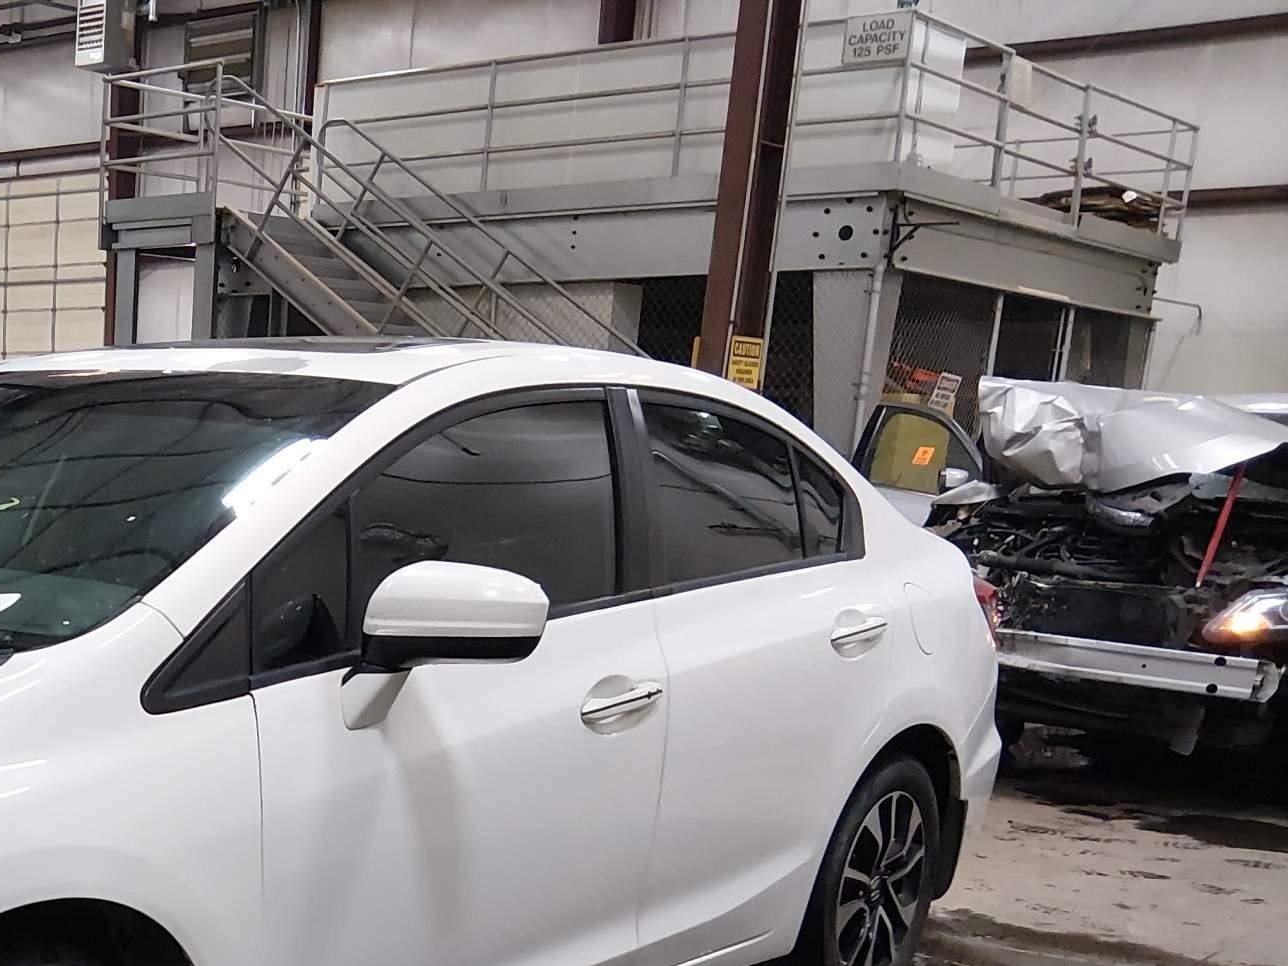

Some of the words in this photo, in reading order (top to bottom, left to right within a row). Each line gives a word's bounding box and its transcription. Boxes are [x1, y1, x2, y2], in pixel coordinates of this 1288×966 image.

[862, 18, 895, 33] LOAD
[848, 30, 906, 46] CAPACITY
[853, 46, 871, 58] 125
[876, 43, 900, 56] PSF
[734, 342, 761, 358] CAUTION
